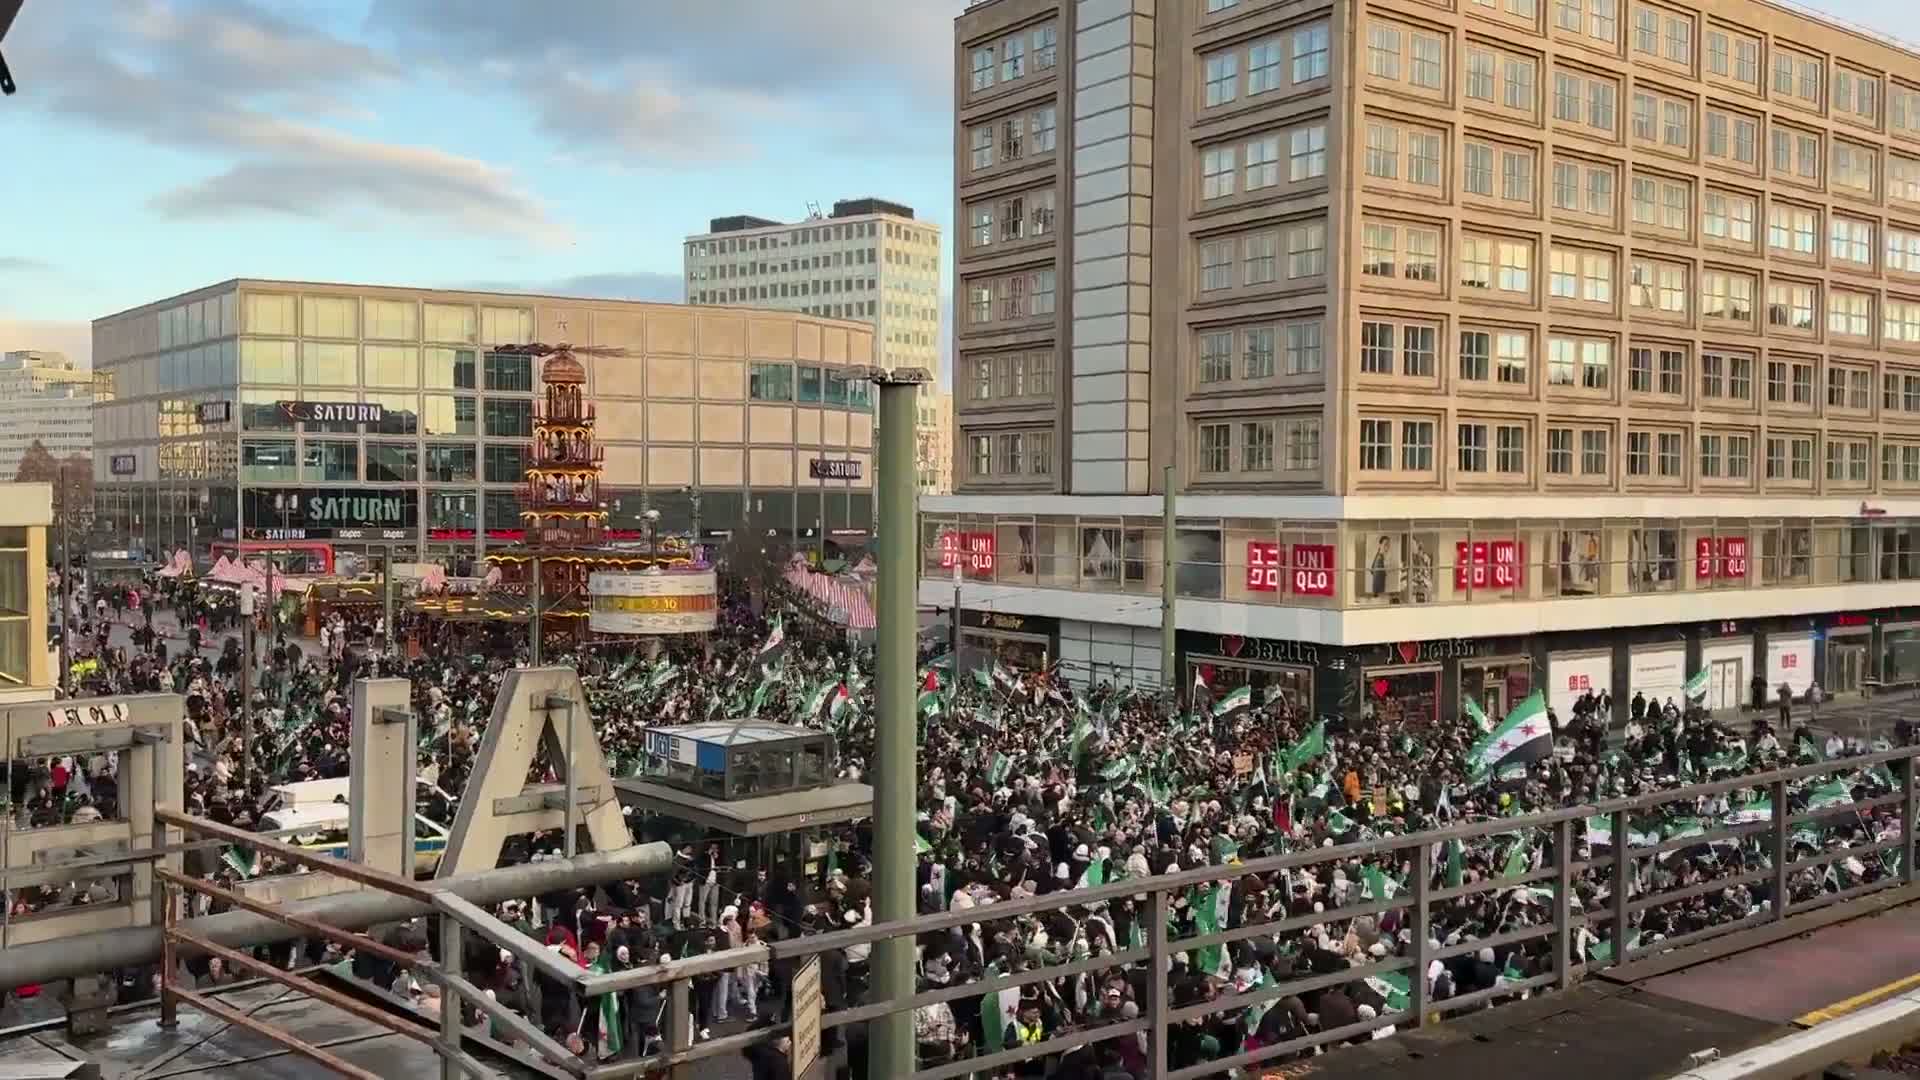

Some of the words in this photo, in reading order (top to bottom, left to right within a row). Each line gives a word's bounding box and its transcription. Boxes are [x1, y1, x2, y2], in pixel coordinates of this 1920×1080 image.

[314, 404, 381, 421] SATURN
[309, 497, 400, 520] SATURN
[265, 530, 305, 540] SATURN
[972, 538, 991, 552] UNI
[1728, 543, 1745, 556] UNI
[972, 554, 993, 570] QLO
[1297, 551, 1325, 569] UNI
[1728, 560, 1746, 575] QLO
[1296, 571, 1328, 592] QLO
